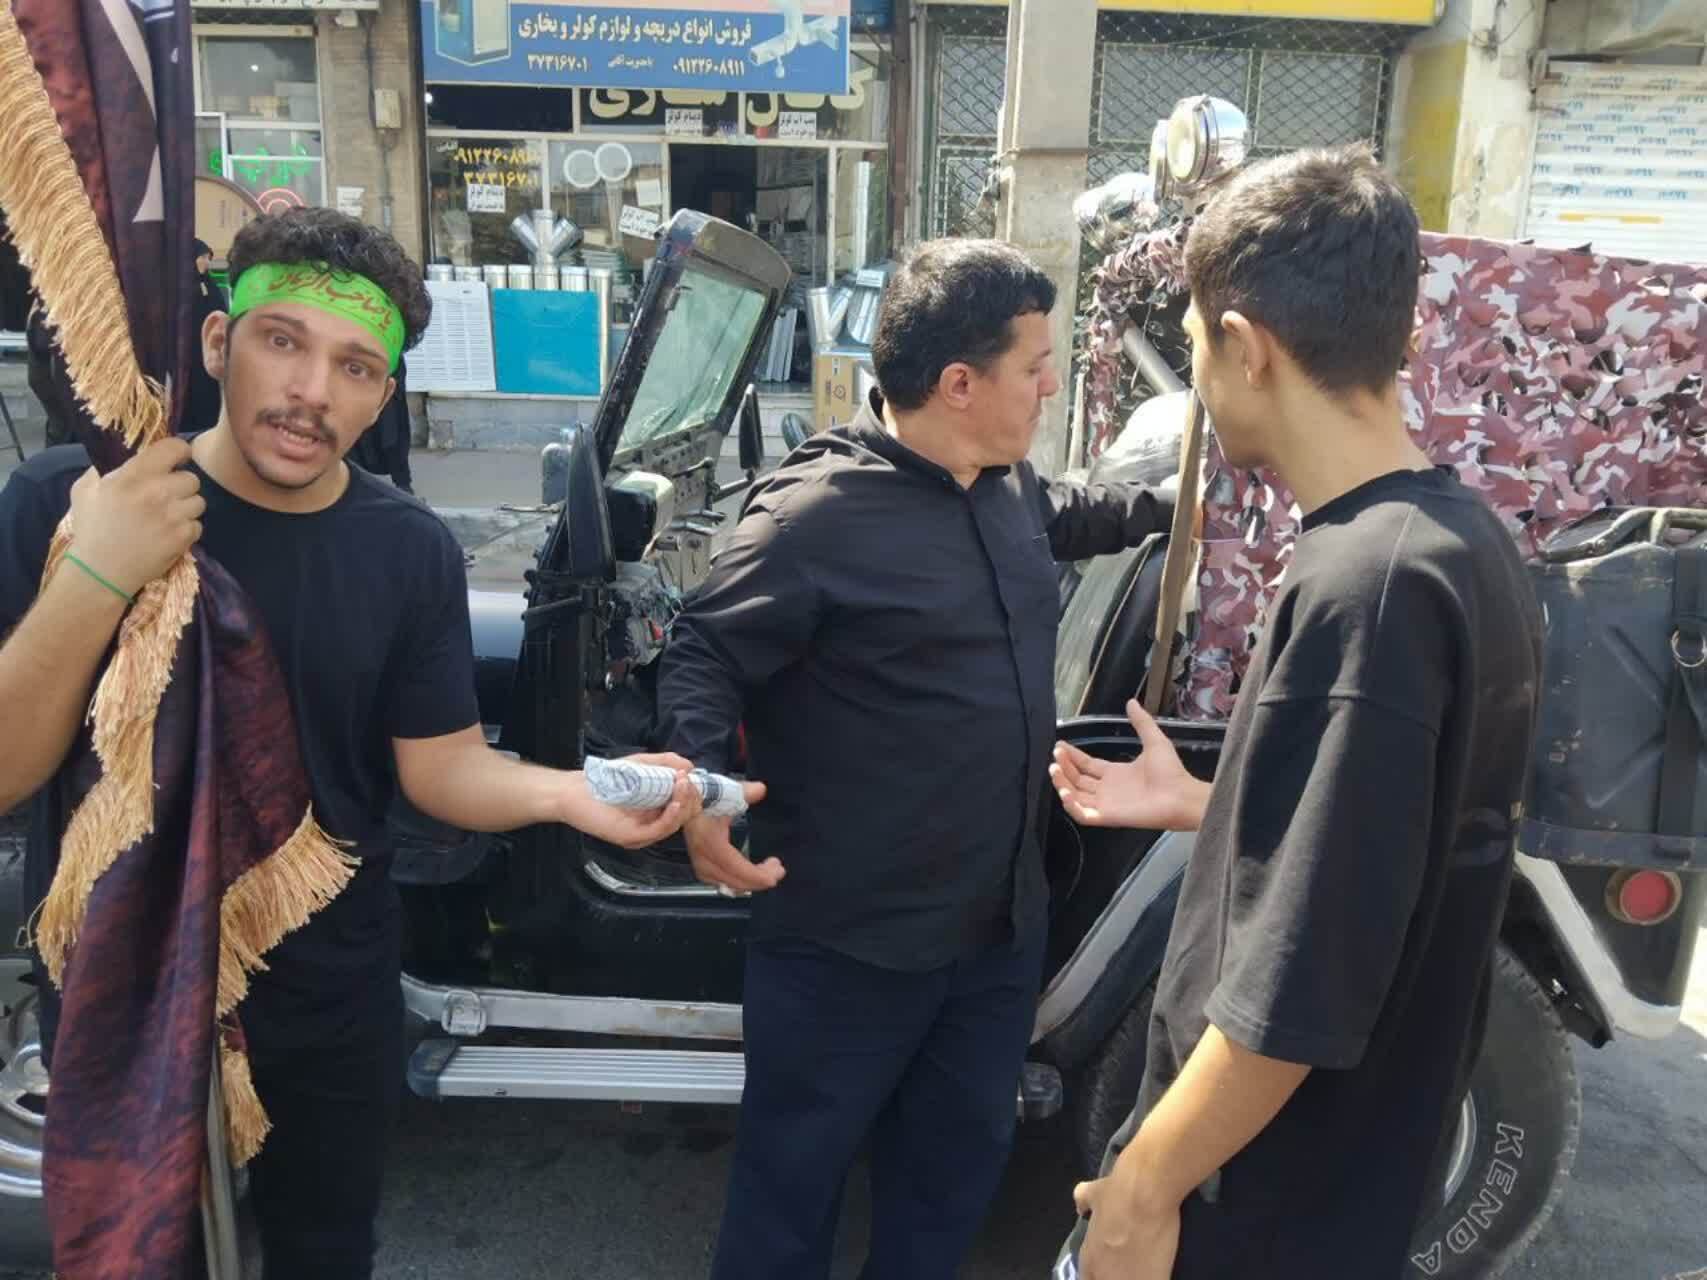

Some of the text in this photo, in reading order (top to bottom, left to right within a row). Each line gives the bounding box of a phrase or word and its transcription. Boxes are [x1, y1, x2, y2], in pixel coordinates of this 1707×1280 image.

[518, 12, 752, 45] فروش انواع دریچه و لوازم کولر و بخاری
[1411, 1121, 1525, 1276] KENDA
